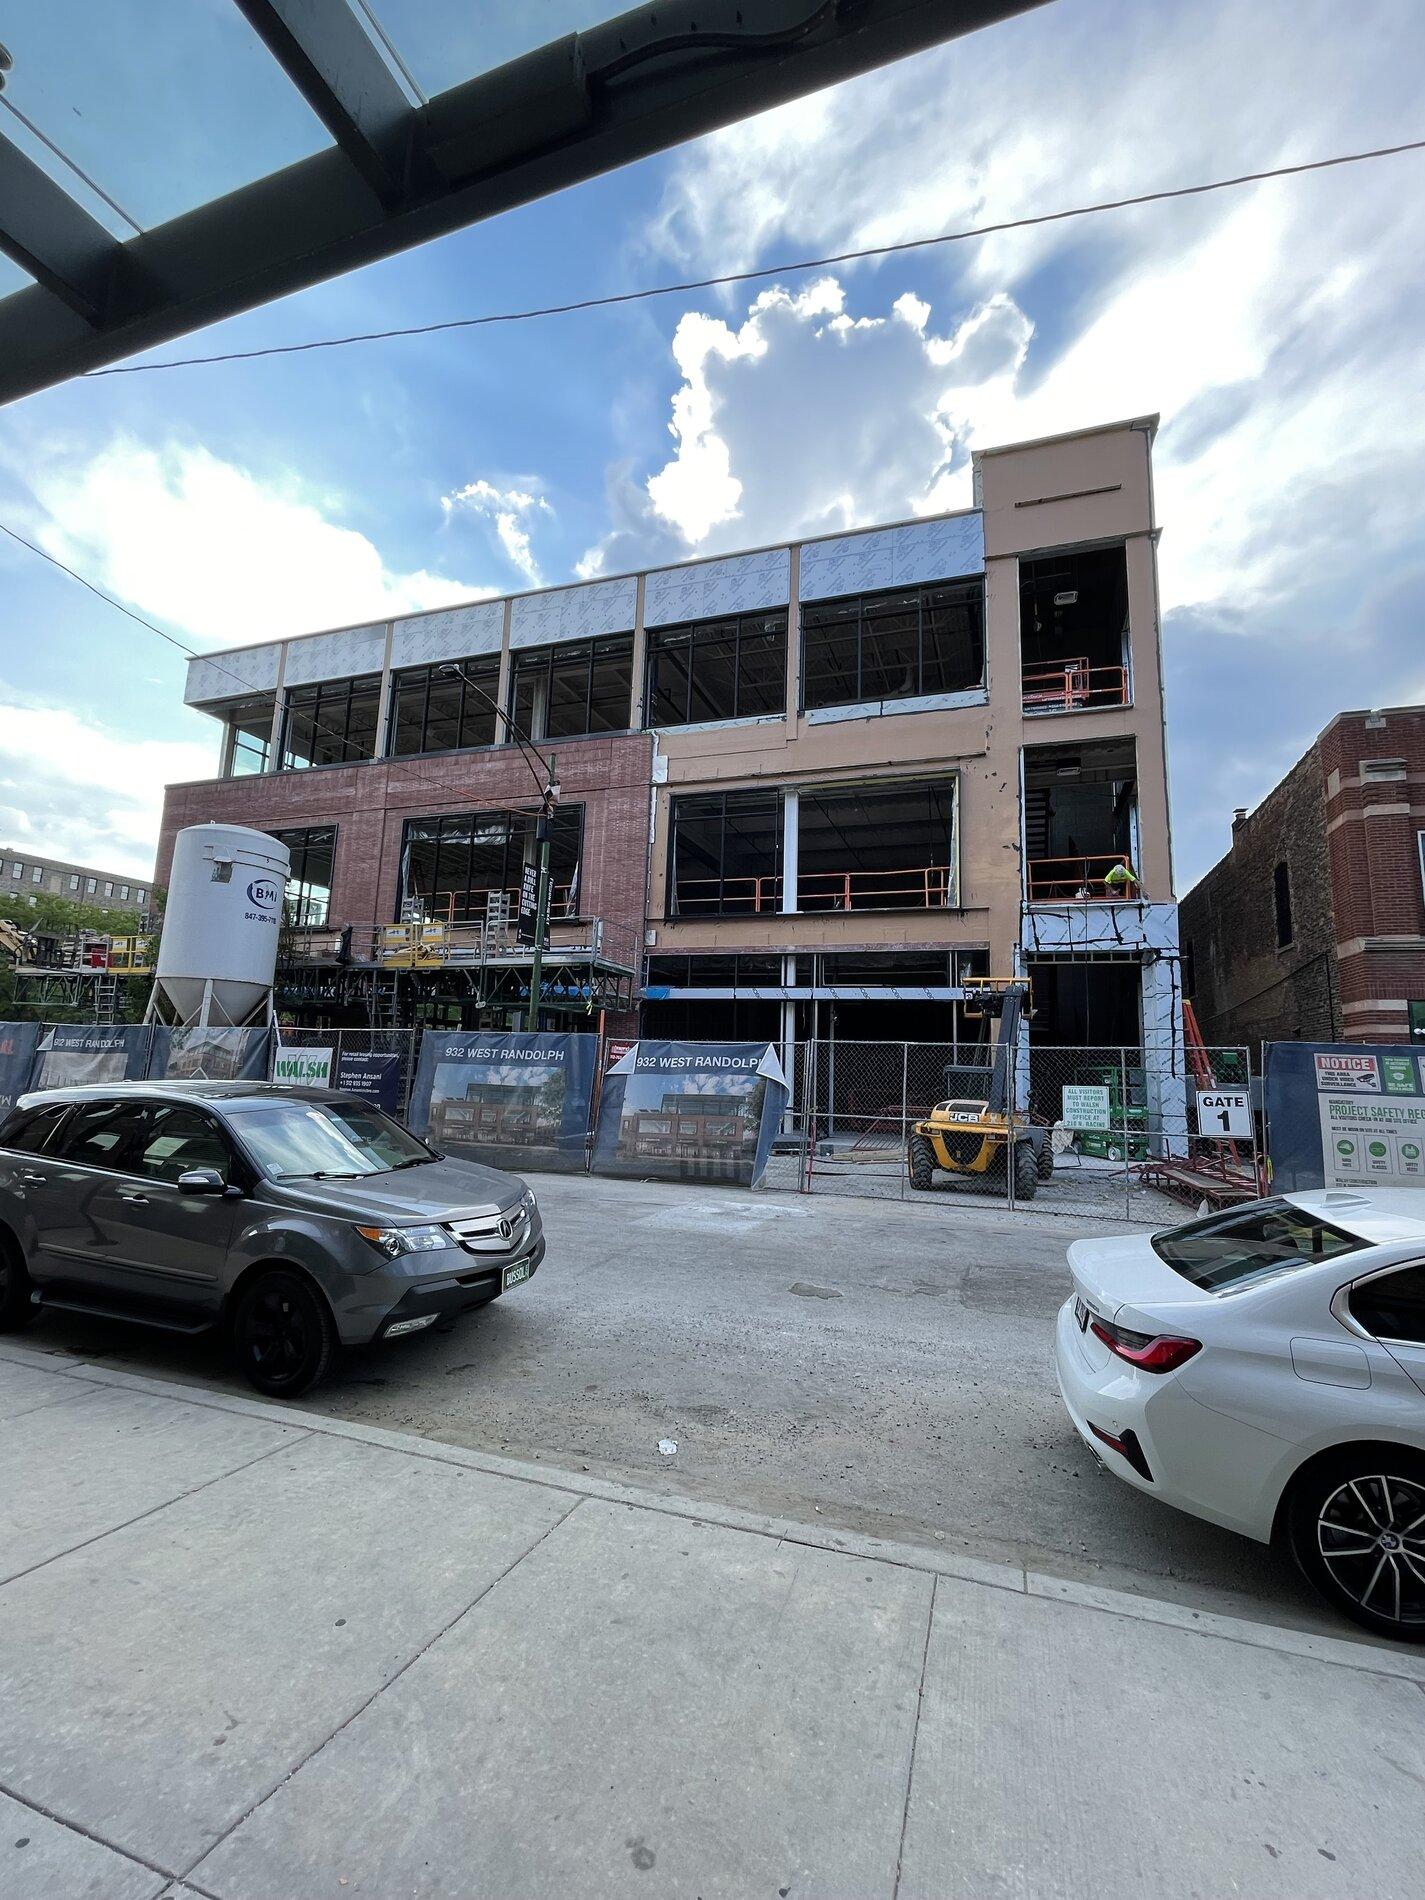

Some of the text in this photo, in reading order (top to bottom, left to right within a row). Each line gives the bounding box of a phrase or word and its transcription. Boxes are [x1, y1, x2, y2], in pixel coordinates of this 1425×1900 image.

[256, 888, 277, 902] BMI
[65, 1039, 83, 1048] WEST
[85, 1039, 125, 1048] RANDOLPH
[445, 1047, 565, 1060] 932 WEST RANDOLPH
[276, 1060, 329, 1078] WALSH
[636, 1057, 656, 1067] 932
[660, 1057, 693, 1068] WEST
[1321, 1057, 1370, 1070] NOTICE
[340, 1072, 362, 1080] Stephen
[1202, 1096, 1244, 1107] GATE
[950, 1113, 979, 1122] JCB
[1329, 1105, 1368, 1117] PROJECT
[1371, 1107, 1405, 1119] SAFETY
[1217, 1110, 1230, 1131] 1
